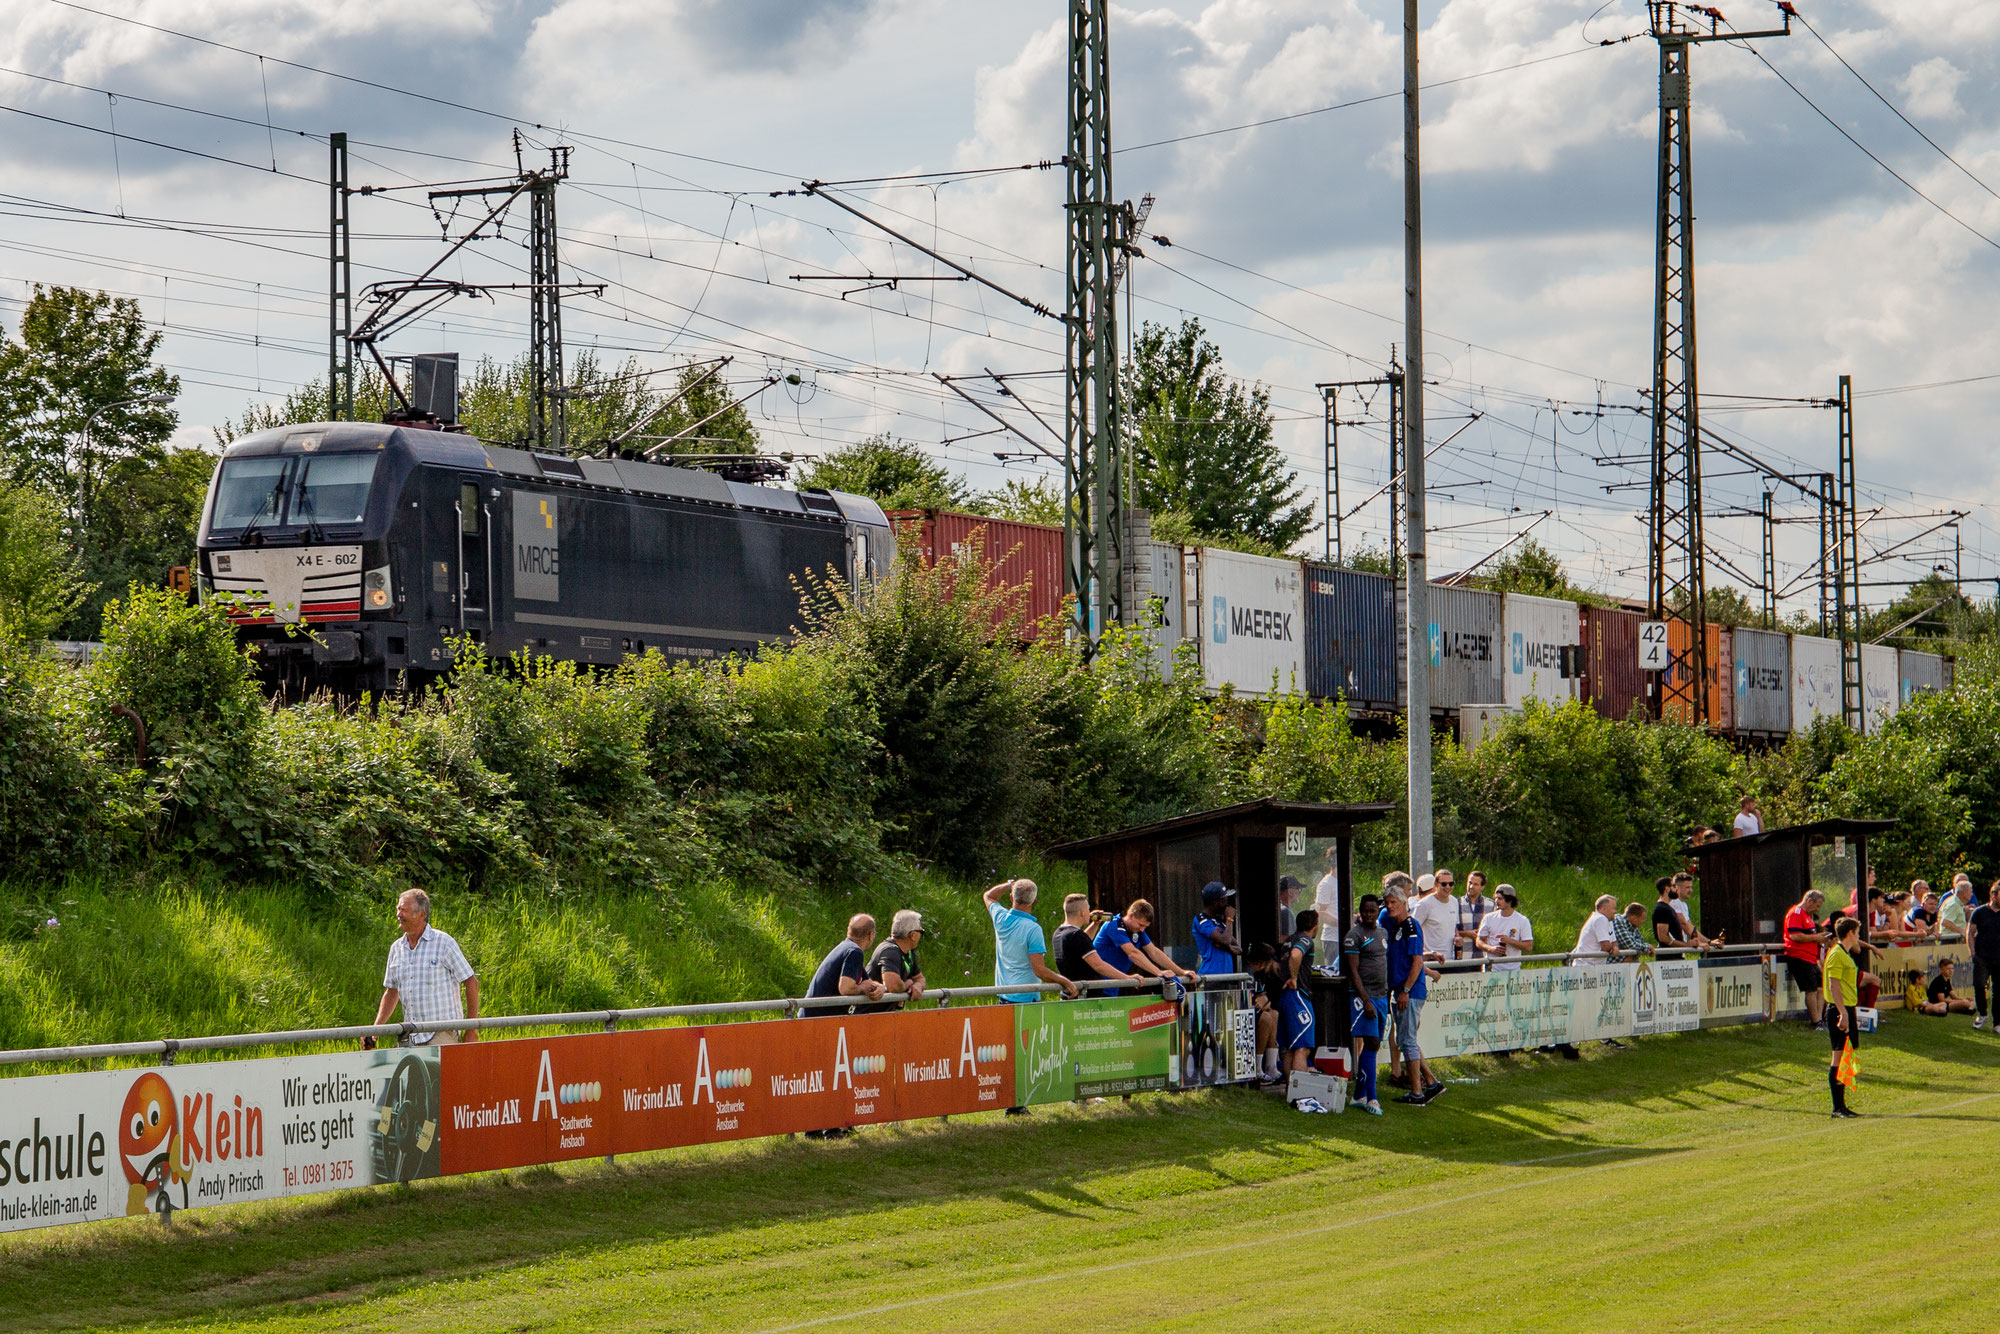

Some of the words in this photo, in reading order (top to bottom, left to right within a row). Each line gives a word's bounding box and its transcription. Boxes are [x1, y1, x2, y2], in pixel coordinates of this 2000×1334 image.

[296, 556, 312, 566] X4
[317, 555, 323, 566] E
[335, 554, 357, 565] 602
[518, 544, 559, 575] MRCE
[1231, 606, 1292, 642] MAERSK
[1642, 625, 1666, 643] 42
[1647, 646, 1659, 663] 4
[1288, 830, 1305, 852] ESV
[1470, 980, 1505, 1006] E-Zigaretten
[1510, 976, 1532, 995] Zubehör
[1560, 974, 1579, 992] Aromen
[1583, 972, 1597, 989] Basen
[1600, 972, 1612, 987] ART
[1715, 976, 1751, 1009] Tucher
[771, 1075, 788, 1096] Wir
[789, 1072, 807, 1095] sind
[808, 1070, 824, 1093] AN.
[904, 1062, 919, 1083] Wir
[919, 1061, 936, 1082] sind
[937, 1058, 951, 1080] AN.
[978, 1074, 1001, 1086] Stadtwerke
[282, 1078, 307, 1107] Wir
[313, 1072, 376, 1106] erklären,
[623, 1088, 641, 1111] Wir
[642, 1085, 664, 1109] sind
[665, 1083, 683, 1107] AN.
[854, 1086, 880, 1100] Stadtwerke
[978, 1089, 996, 1101] Ansbach
[453, 1105, 475, 1129] Wir
[476, 1102, 500, 1127] sind
[501, 1099, 521, 1124] AN.
[716, 1099, 744, 1114] Stadtwerke
[855, 1102, 874, 1115] Ansbach
[183, 1093, 263, 1166] Klein
[282, 1115, 317, 1146] wies
[322, 1110, 354, 1150] geht
[560, 1115, 592, 1131] Stadtwerke
[716, 1116, 738, 1131] Ansbach
[0, 1114, 105, 1186] schule
[560, 1133, 585, 1148] Ansbach
[198, 1177, 225, 1200] Andy
[229, 1170, 264, 1194] Prirsch
[283, 1166, 300, 1187] Tel.
[302, 1162, 326, 1185] 0981
[330, 1159, 354, 1181] 3675
[1, 1189, 97, 1222] hule-klein-an.de
